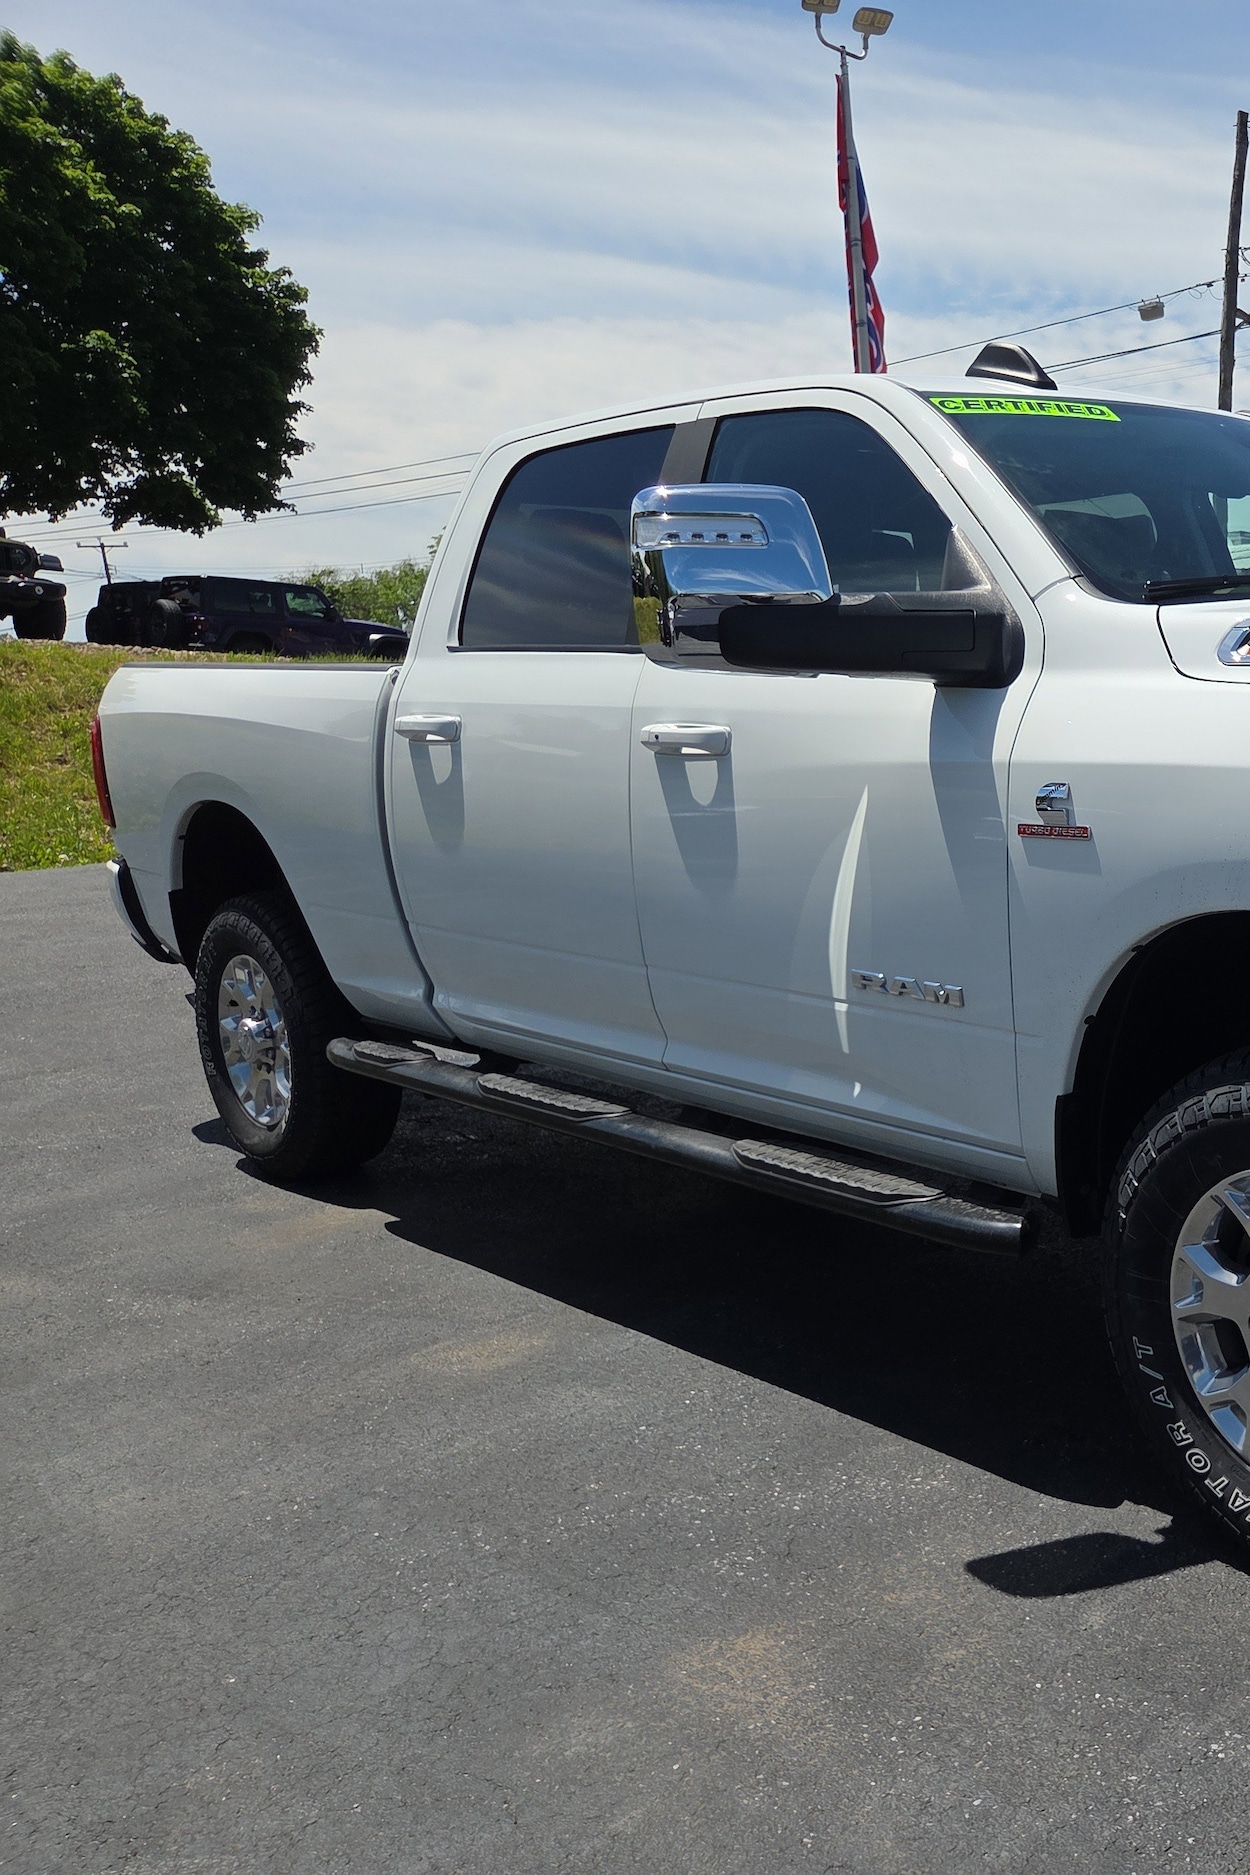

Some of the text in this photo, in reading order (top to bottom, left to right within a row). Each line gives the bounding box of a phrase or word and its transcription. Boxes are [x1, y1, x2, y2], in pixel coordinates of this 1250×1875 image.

[938, 399, 1109, 417] CERTIFIED
[1019, 825, 1088, 837] TURBO DIESEL
[851, 968, 965, 1007] RAM
[1133, 1336, 1173, 1409] A/T
